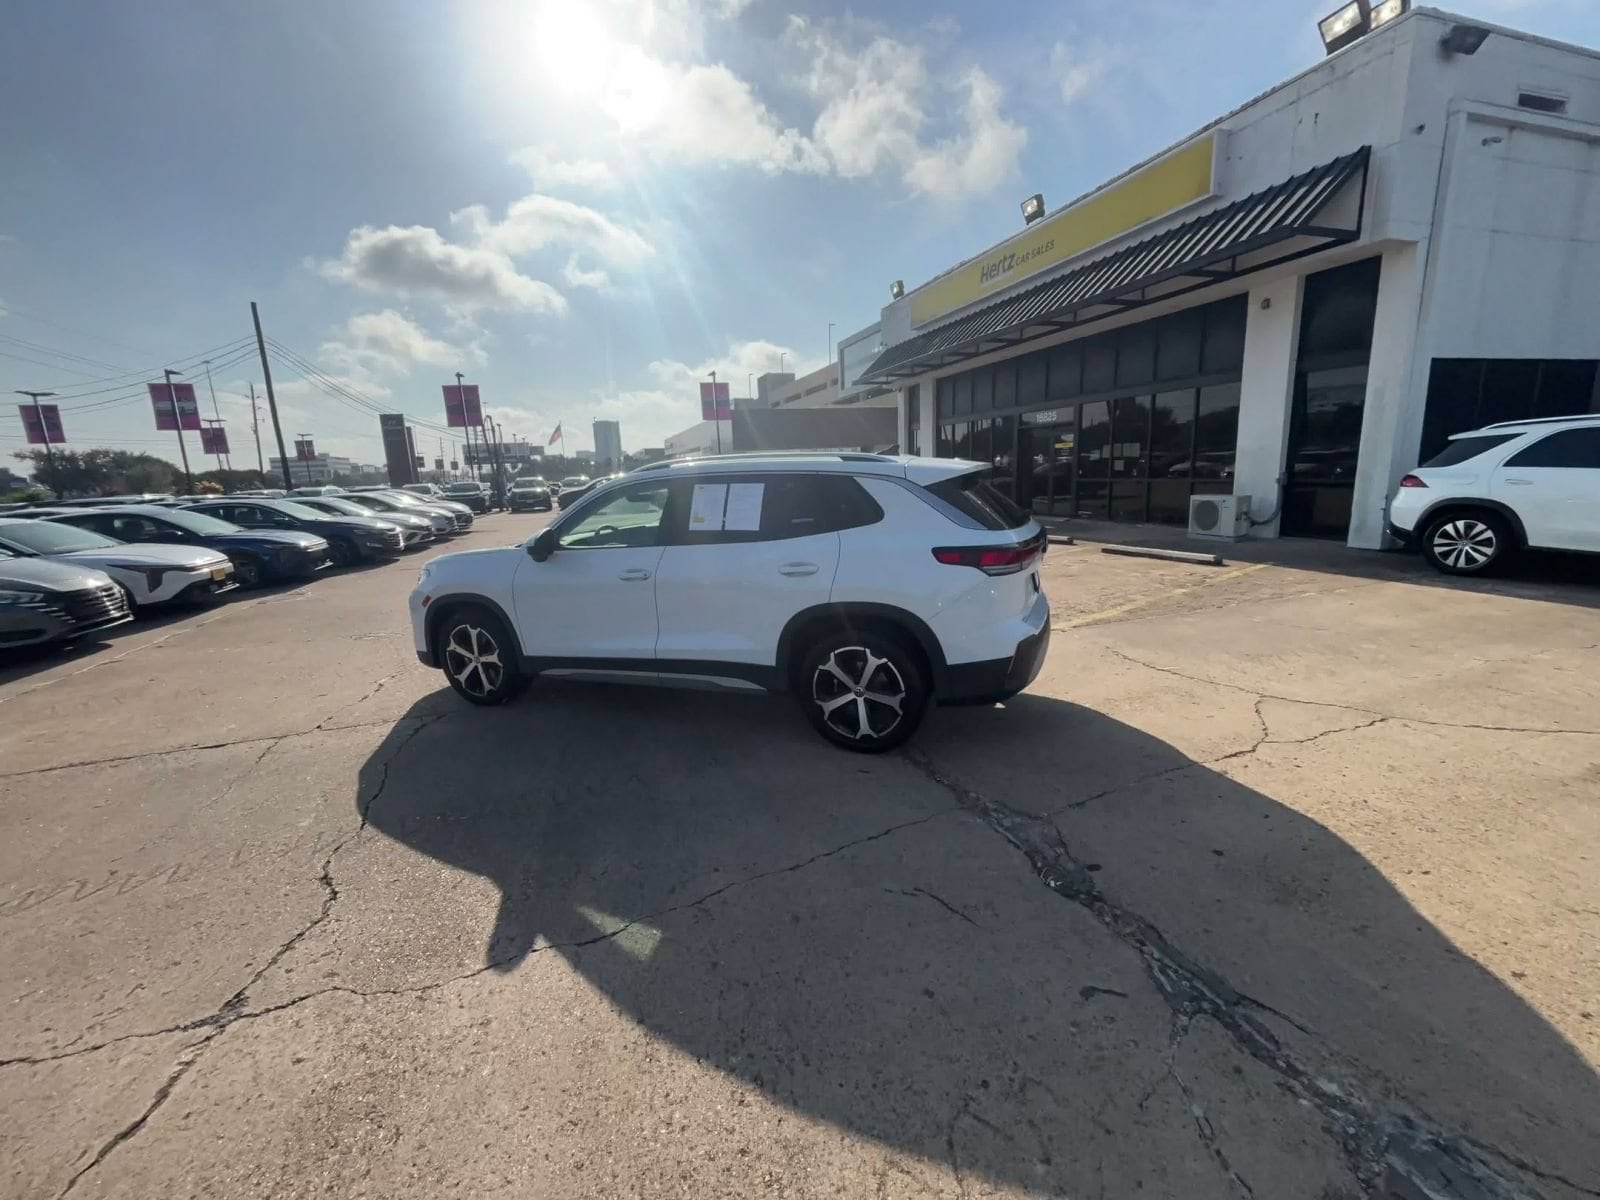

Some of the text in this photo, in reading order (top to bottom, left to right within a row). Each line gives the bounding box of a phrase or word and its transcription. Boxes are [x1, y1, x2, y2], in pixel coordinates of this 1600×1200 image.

[981, 239, 1055, 284] Hertz CAR SALES
